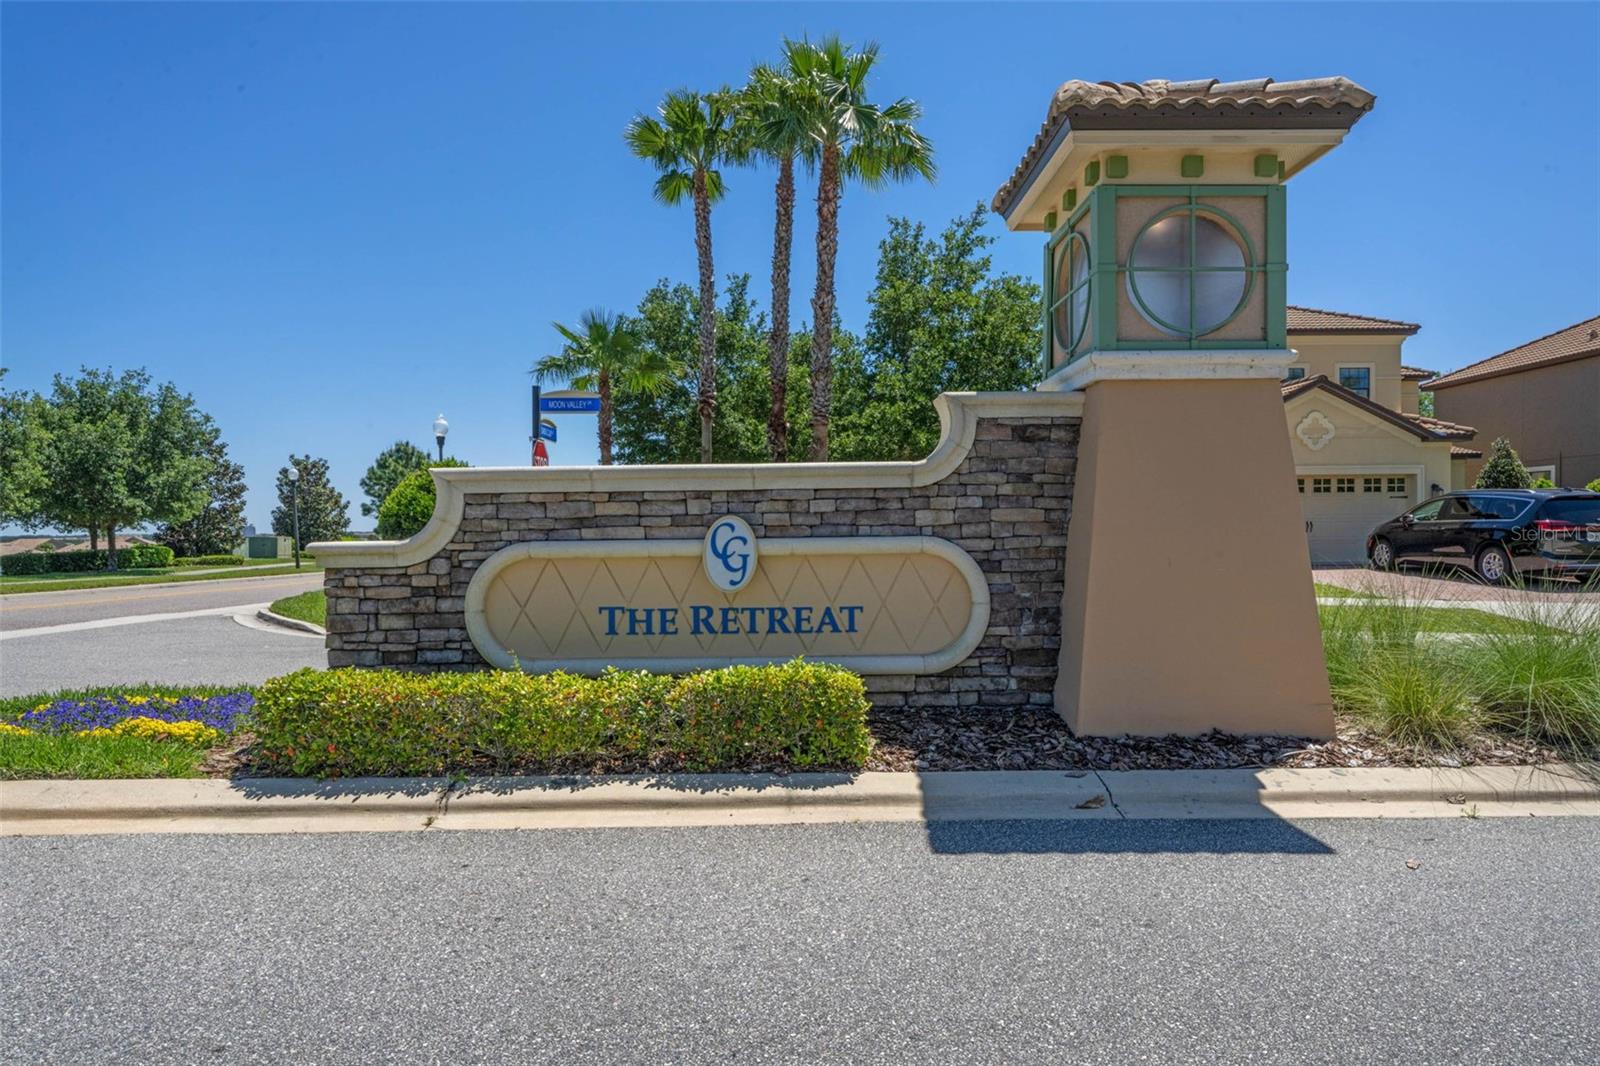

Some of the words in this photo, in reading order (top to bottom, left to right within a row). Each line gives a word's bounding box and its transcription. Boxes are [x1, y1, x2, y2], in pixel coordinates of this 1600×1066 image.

[548, 400, 566, 409] MOON
[567, 400, 586, 409] VALLEY
[710, 522, 749, 586] CG
[599, 606, 678, 635] THE
[690, 606, 863, 635] RETREAT
